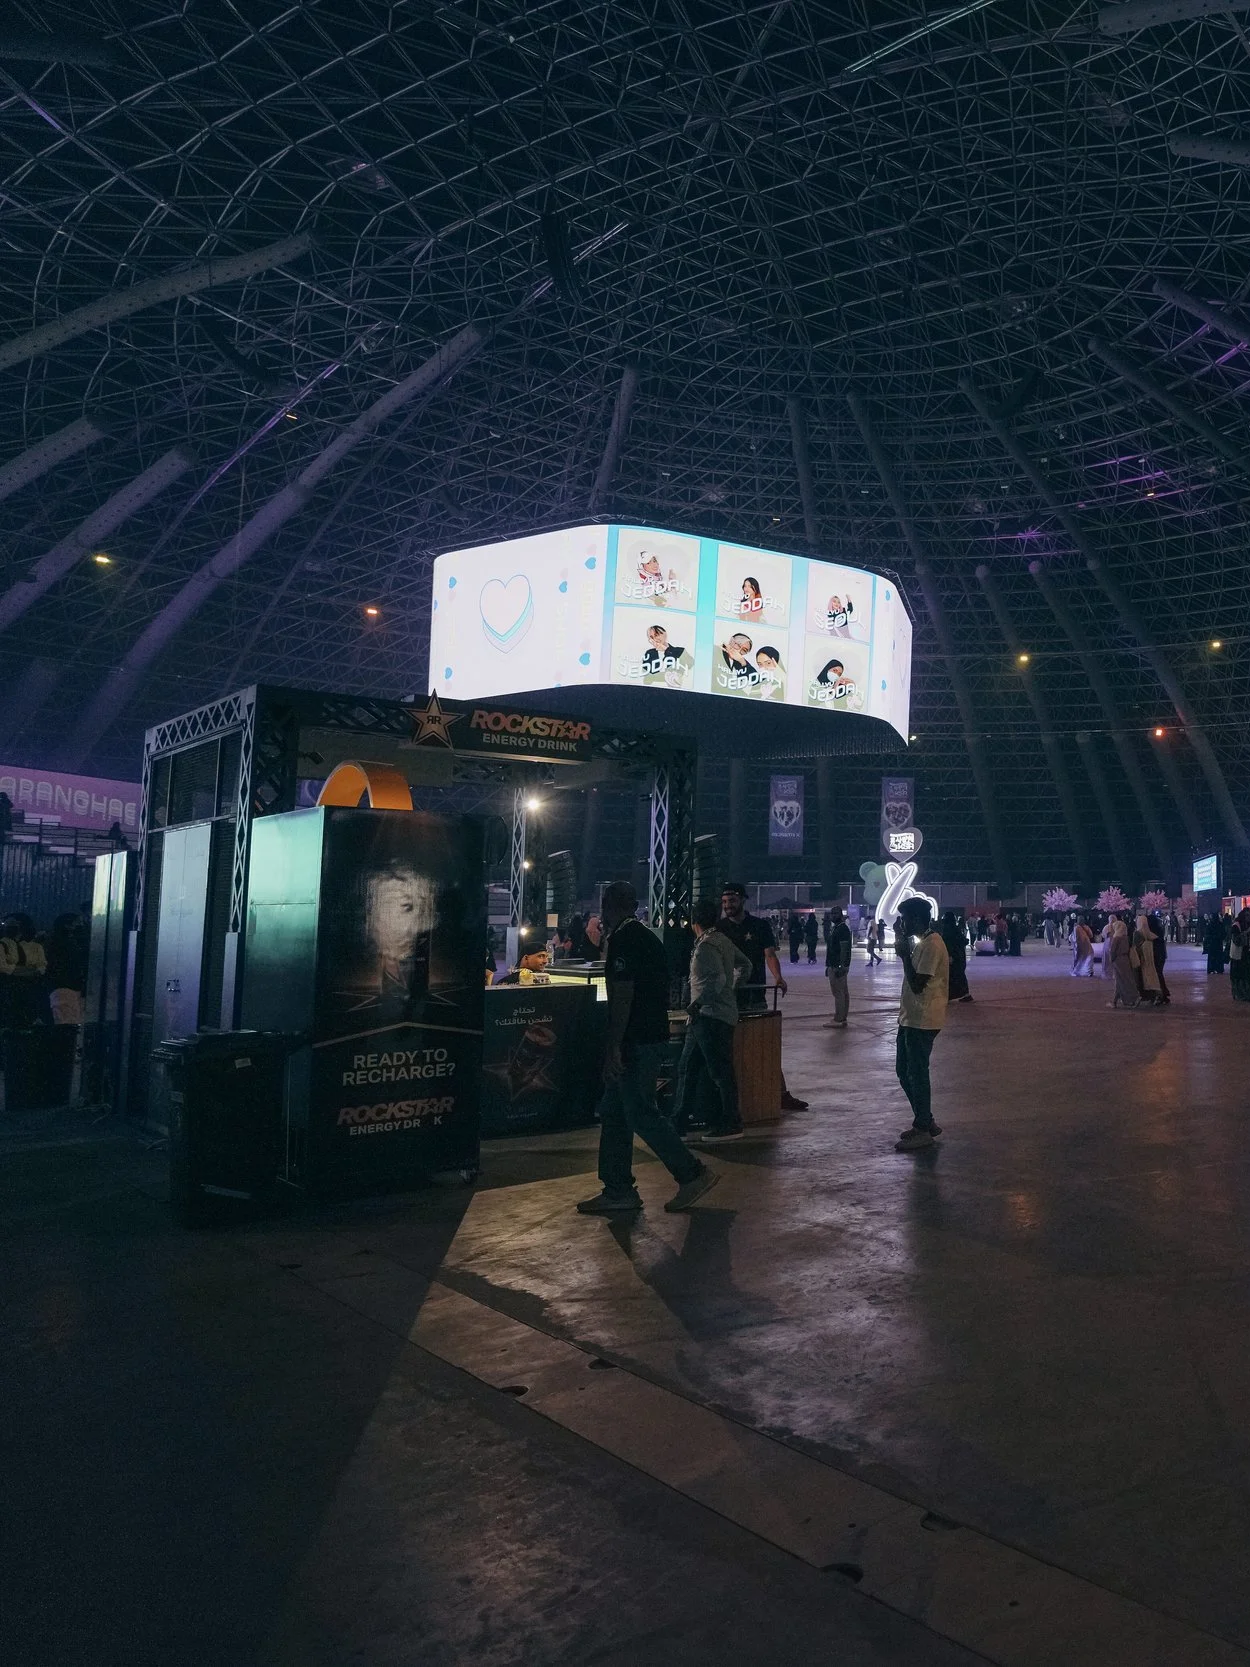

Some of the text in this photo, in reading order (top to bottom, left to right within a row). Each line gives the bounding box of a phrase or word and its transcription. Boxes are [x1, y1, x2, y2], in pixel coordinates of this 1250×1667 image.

[621, 580, 693, 600] JEDDAH
[720, 596, 785, 614] JEDDAH
[813, 609, 866, 630] SEOUL
[618, 657, 688, 678] JEDDAH
[718, 664, 747, 674] HALLYU
[717, 670, 782, 690] JEDDAH
[808, 683, 864, 702] JEDDAH
[470, 710, 591, 741] ROCKSTAR
[482, 733, 577, 752] ENERGY DRINK
[353, 1048, 448, 1069] READY TO
[342, 1062, 456, 1086] RECHARGE?
[337, 1096, 456, 1125] ROCKSTAR
[349, 1115, 442, 1136] ENERGY DRK
